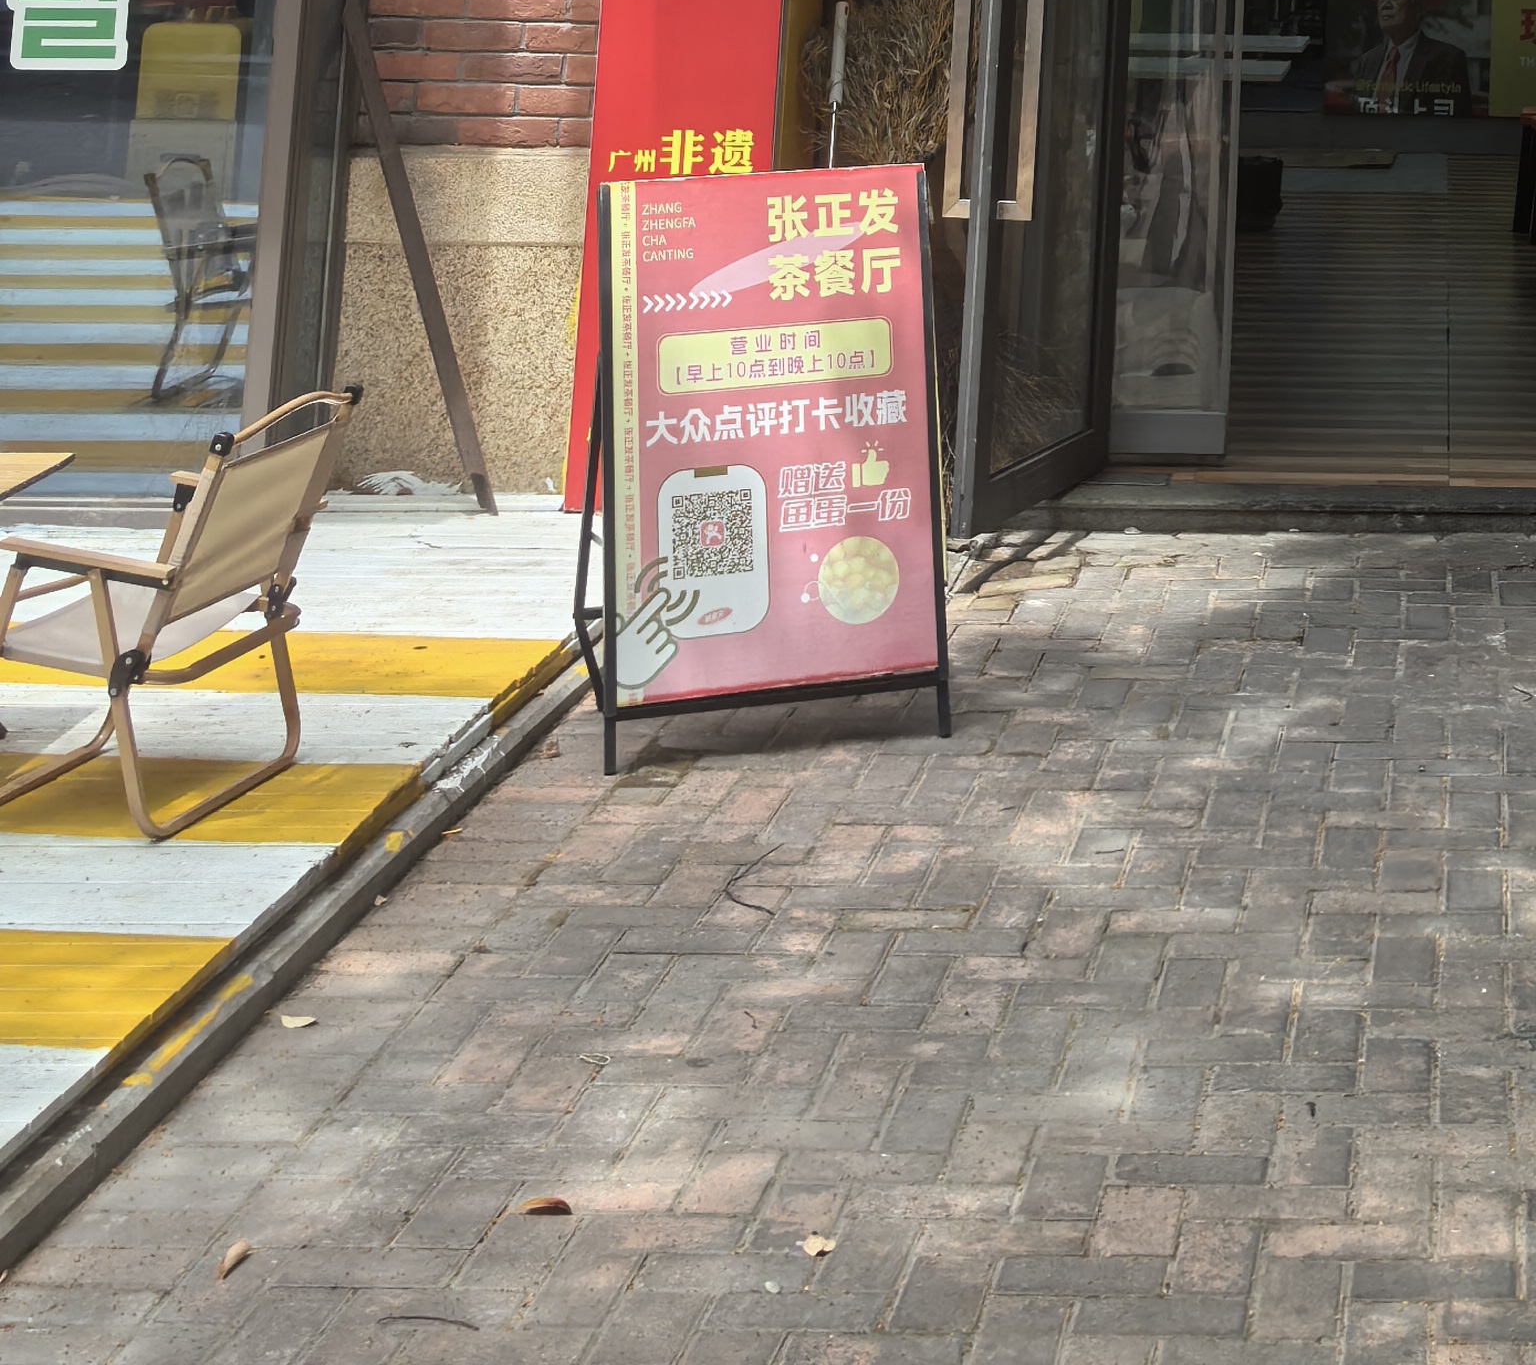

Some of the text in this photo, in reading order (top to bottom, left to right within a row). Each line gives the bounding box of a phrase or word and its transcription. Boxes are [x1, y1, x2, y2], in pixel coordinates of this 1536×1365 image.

[642, 202, 682, 216] ZHANG
[642, 217, 696, 232] ZHENGFA
[767, 188, 900, 245] 张正发
[642, 233, 667, 247] CHA
[642, 248, 695, 264] CANTING
[767, 245, 901, 302] 茶餐厅
[729, 328, 821, 357] 营业时间
[646, 389, 908, 449] 大众点评打卡收藏
[777, 461, 847, 499] 赠送
[778, 487, 912, 533] 鱼蛋一份
